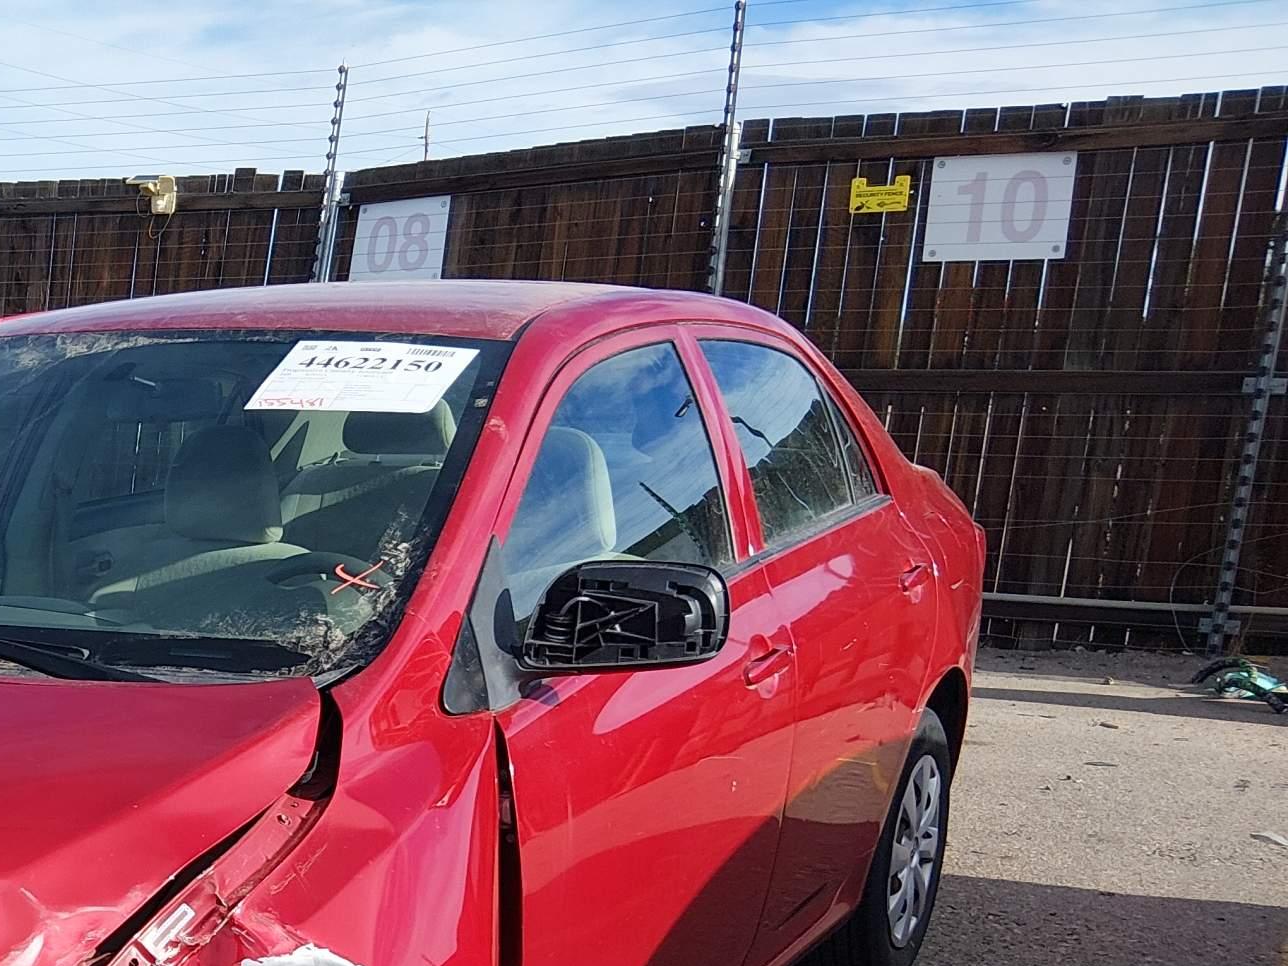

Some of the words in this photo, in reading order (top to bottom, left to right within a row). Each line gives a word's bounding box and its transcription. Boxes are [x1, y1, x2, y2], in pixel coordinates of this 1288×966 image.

[957, 169, 1049, 243] 10
[367, 212, 431, 273] 08
[298, 354, 443, 373] 44622150
